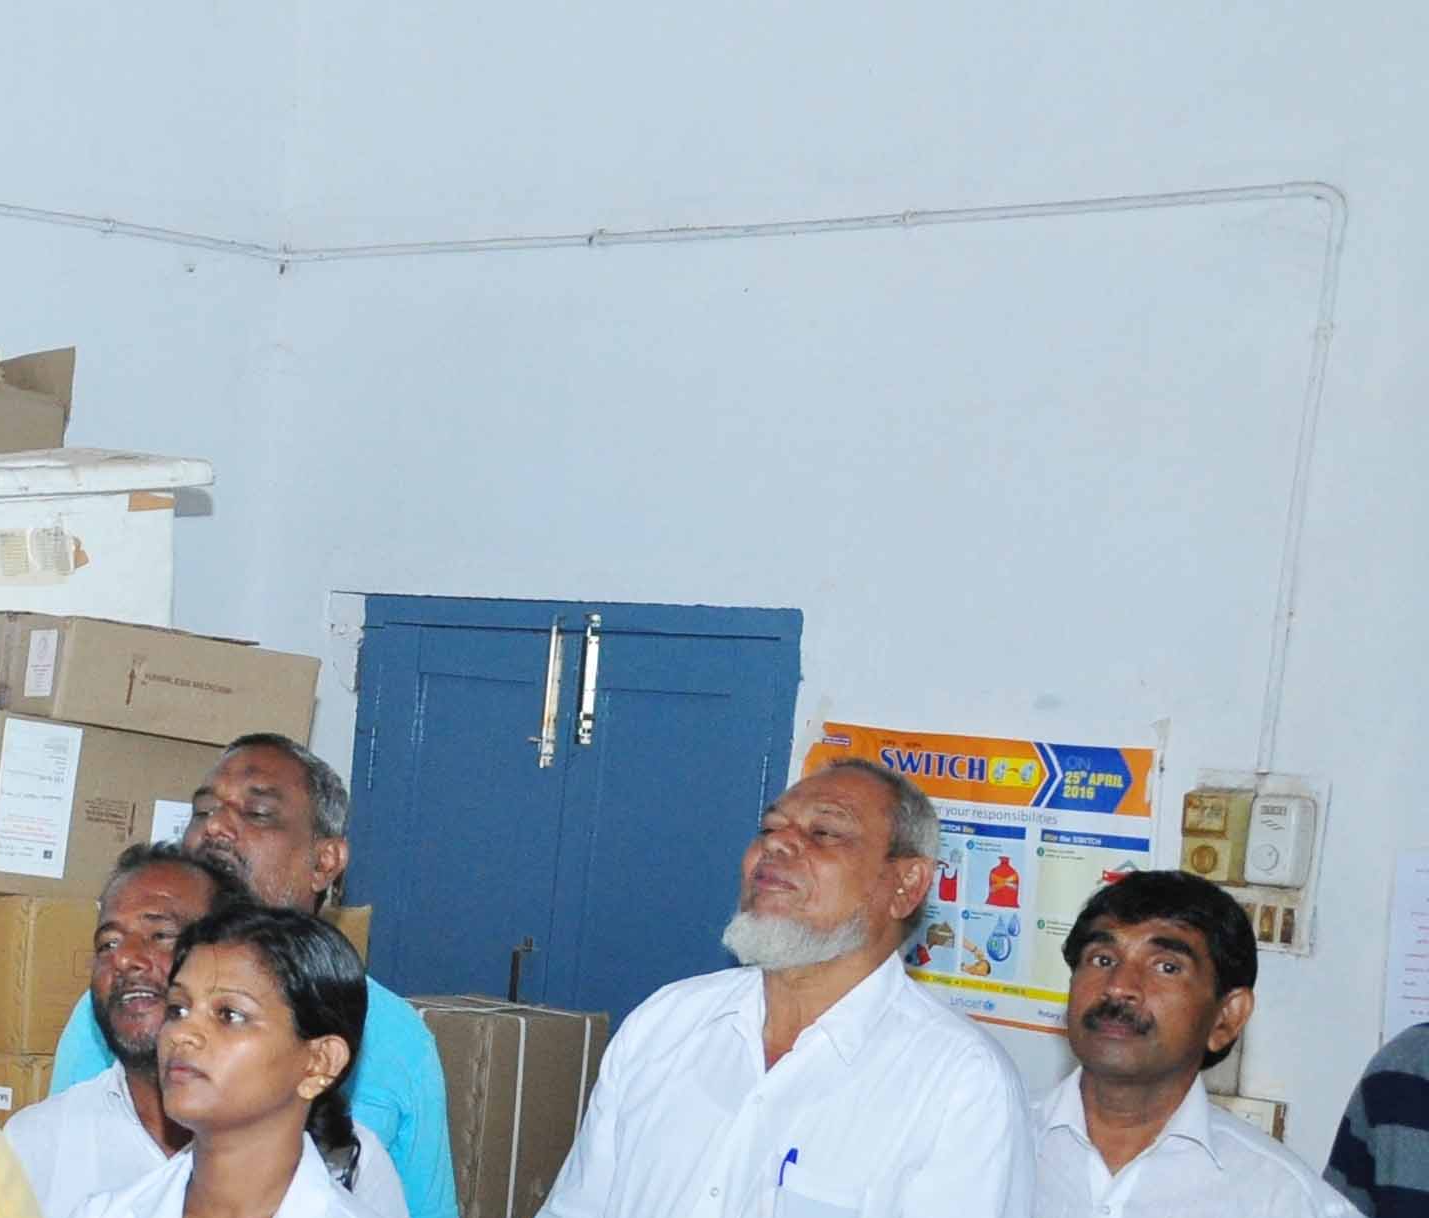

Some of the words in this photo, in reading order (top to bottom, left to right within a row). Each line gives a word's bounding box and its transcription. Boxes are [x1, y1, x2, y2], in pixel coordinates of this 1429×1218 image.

[880, 748, 987, 781] SWITCH
[1066, 756, 1090, 770] ON
[1088, 773, 1124, 788] APRIL
[1062, 785, 1096, 799] 2016
[945, 806, 970, 819] your
[971, 810, 1059, 826] responsibilities
